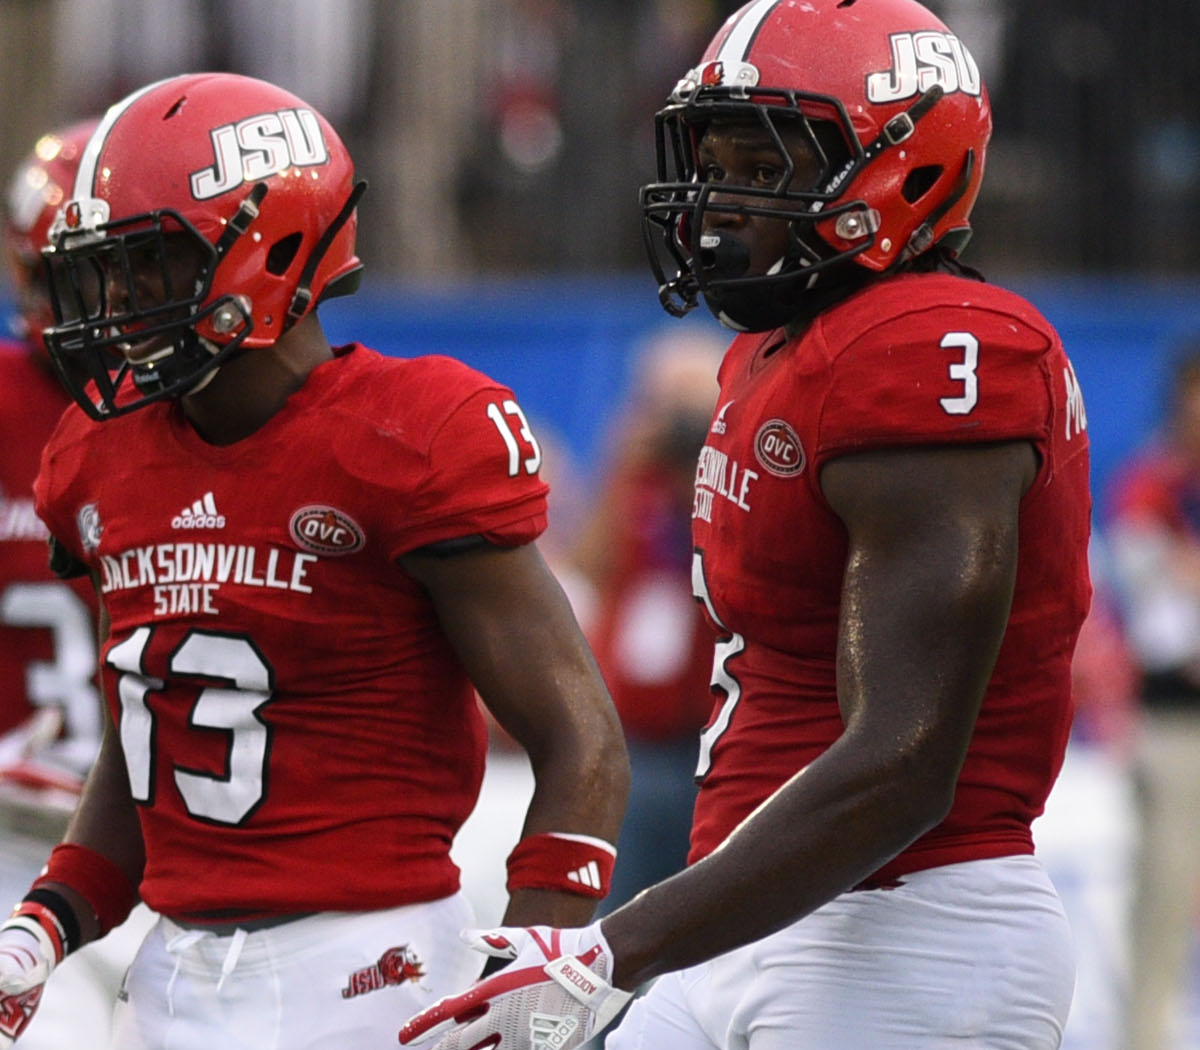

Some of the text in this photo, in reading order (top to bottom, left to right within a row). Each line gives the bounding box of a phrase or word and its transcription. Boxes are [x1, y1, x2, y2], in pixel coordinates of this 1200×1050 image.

[865, 29, 981, 104] JSU
[189, 108, 331, 201] JSU
[939, 331, 980, 416] 3
[486, 398, 541, 477] 13
[764, 434, 793, 463] OVC
[171, 514, 227, 530] adidas
[304, 519, 347, 545] OVC
[101, 543, 318, 594] JACKSONVILLE
[154, 583, 220, 616] STATE
[104, 624, 275, 828] 13
[341, 962, 387, 999] JSU
